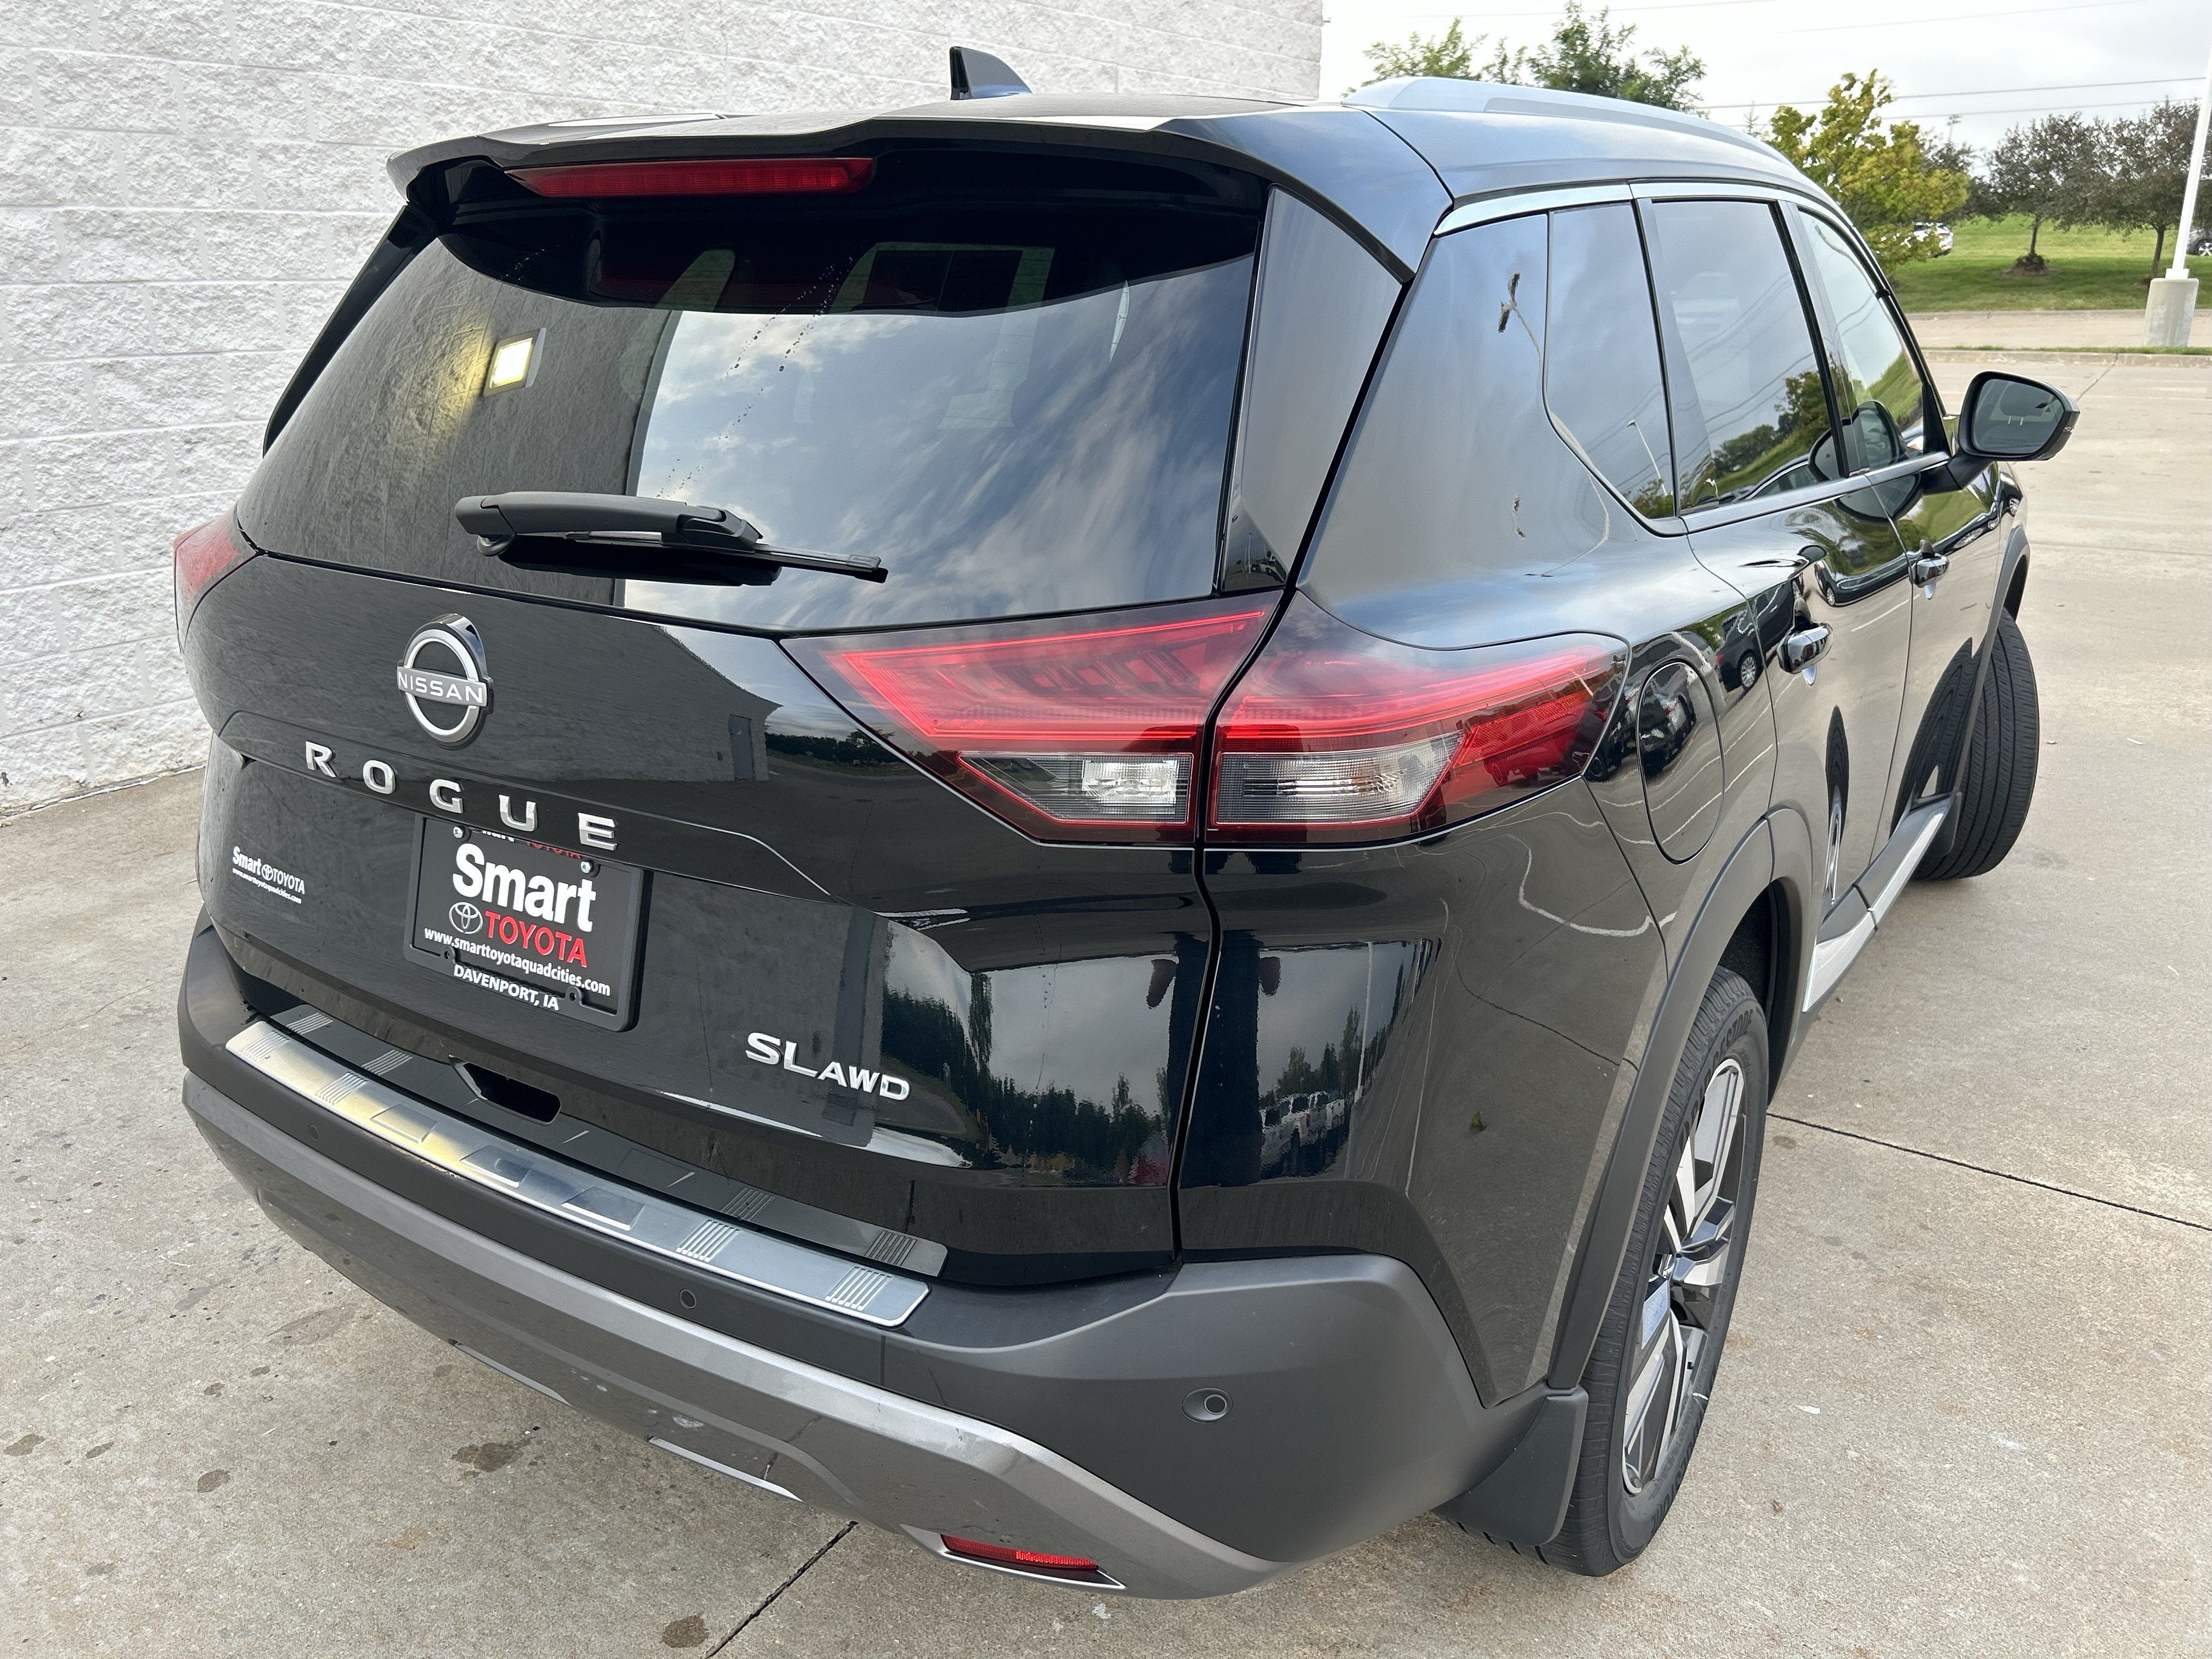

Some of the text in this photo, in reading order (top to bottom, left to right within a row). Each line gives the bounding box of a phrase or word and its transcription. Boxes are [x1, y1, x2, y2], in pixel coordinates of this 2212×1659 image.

[397, 670, 484, 704] NISSAN
[305, 741, 619, 851] ROGUE
[233, 845, 305, 894] Smart TOYOTA
[453, 843, 596, 932] Smart
[424, 928, 610, 996] www.smarttoyotaquadcities.com
[485, 910, 588, 968] TOYOTA
[454, 964, 560, 1011] DAVENPORT, IA
